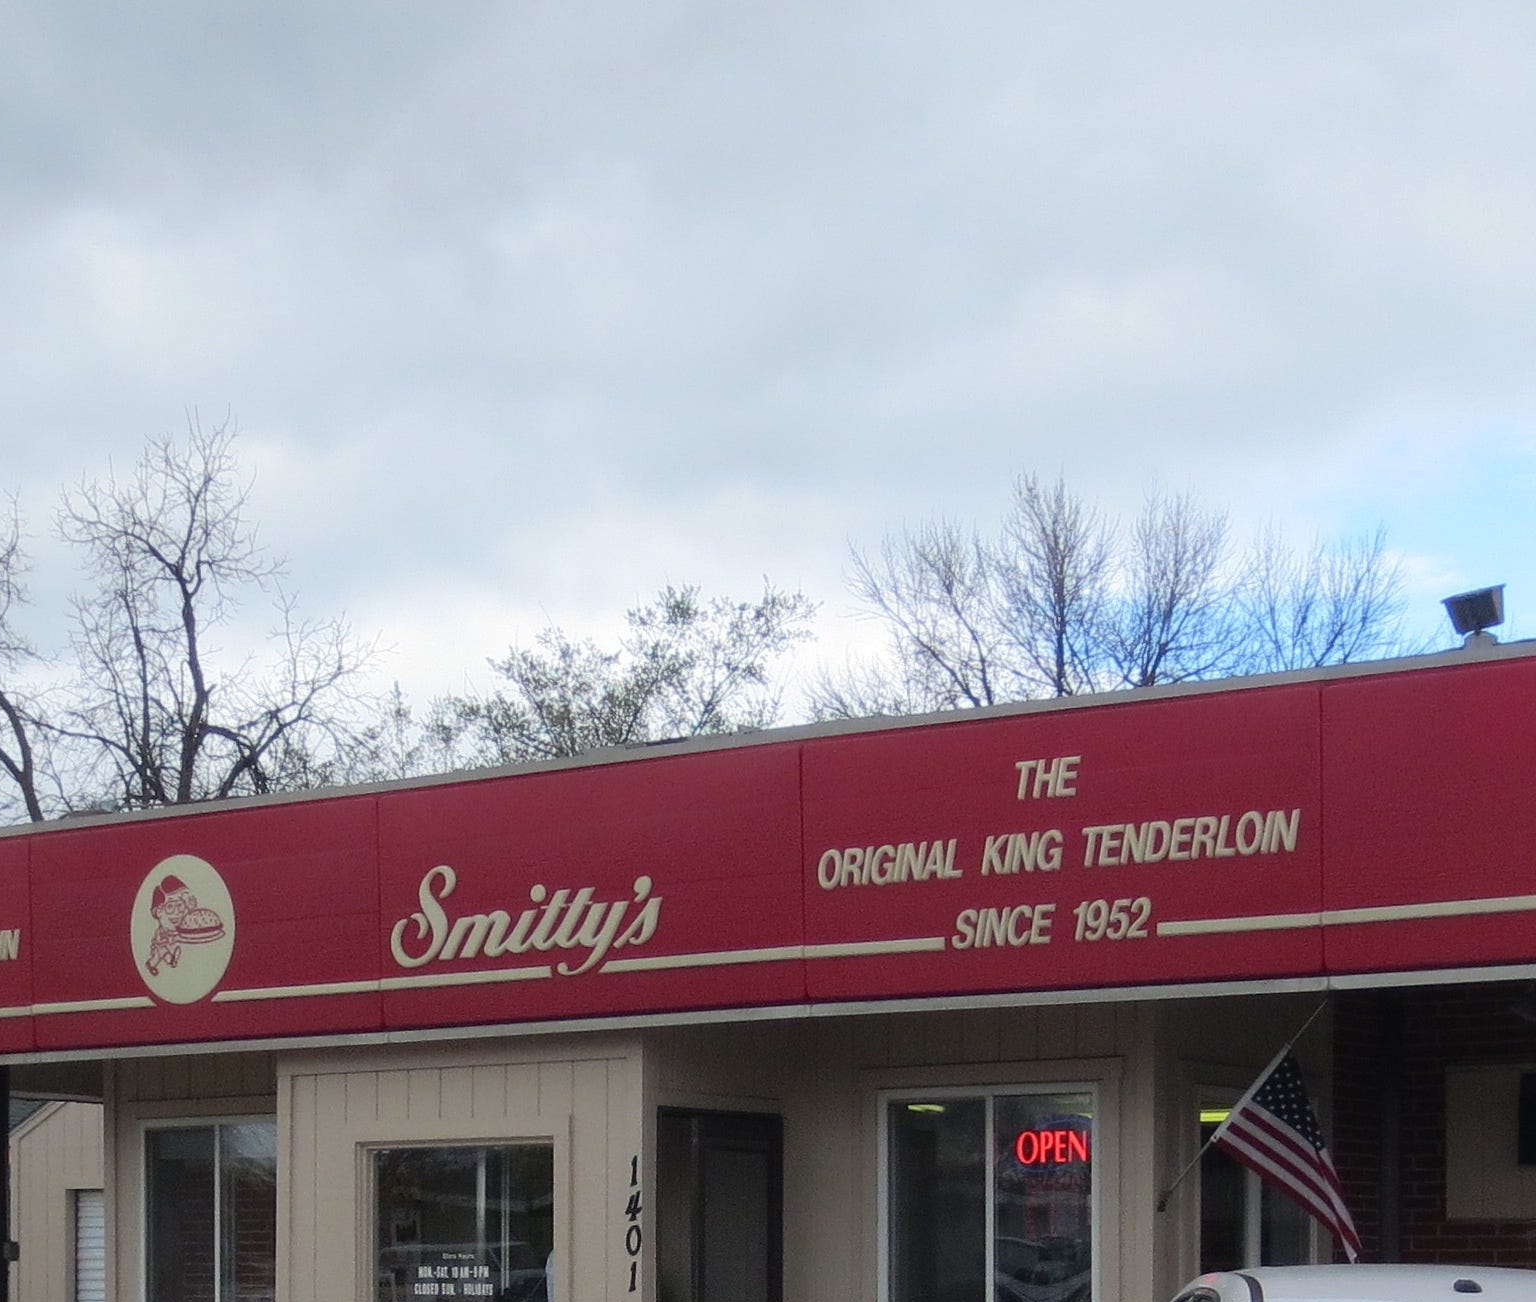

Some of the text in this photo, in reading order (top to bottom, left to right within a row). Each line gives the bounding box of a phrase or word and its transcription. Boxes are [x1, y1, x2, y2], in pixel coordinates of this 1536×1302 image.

[1014, 756, 1082, 799] THE
[817, 808, 1300, 891] ORIGINAL KING TENDERLOIN
[390, 864, 663, 977] Smitty's
[951, 897, 1152, 951] SINCE 1952
[1017, 1131, 1088, 1164] OPEN
[625, 1155, 642, 1292] 1401
[414, 1283, 439, 1295] CLOSED
